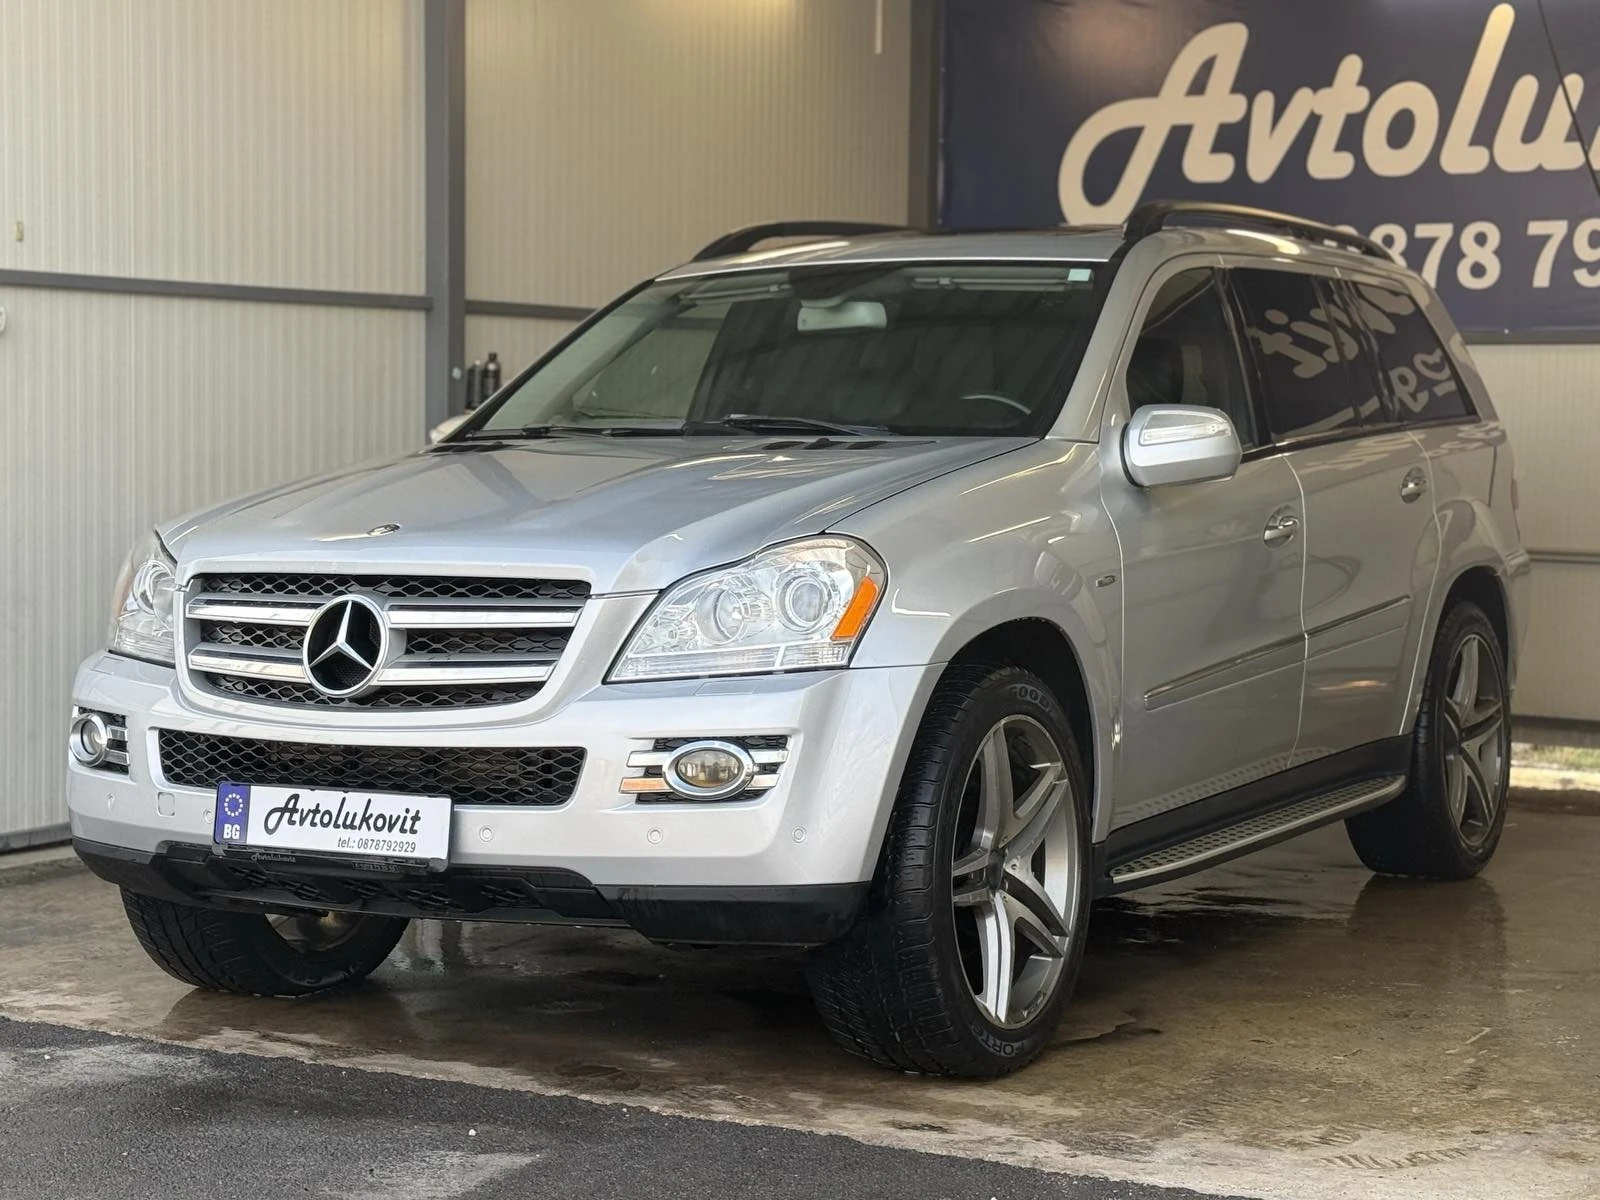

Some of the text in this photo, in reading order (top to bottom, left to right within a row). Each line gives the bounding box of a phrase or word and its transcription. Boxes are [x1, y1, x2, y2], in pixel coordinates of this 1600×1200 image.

[1058, 3, 1600, 226] Avtolu
[264, 793, 422, 836] Avtolukovit
[223, 823, 240, 840] BG
[337, 836, 416, 853] tel.: 0878792929
